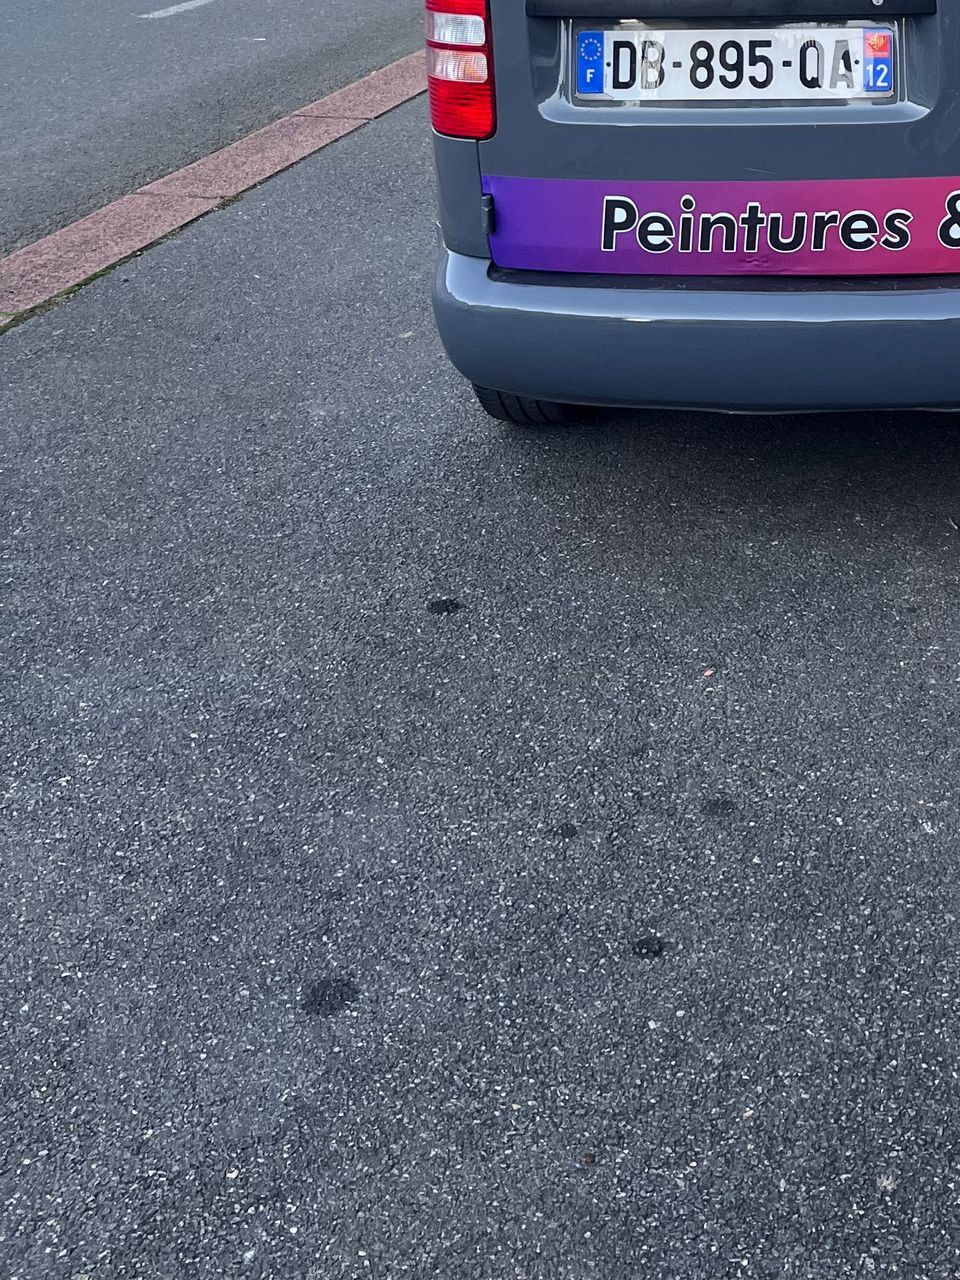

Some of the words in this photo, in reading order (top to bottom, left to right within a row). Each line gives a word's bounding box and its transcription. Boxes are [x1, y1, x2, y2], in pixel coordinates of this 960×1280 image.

[586, 69, 595, 83] F
[613, 40, 854, 89] DB-895-QA
[866, 64, 889, 87] 12
[601, 194, 914, 253] Peintures
